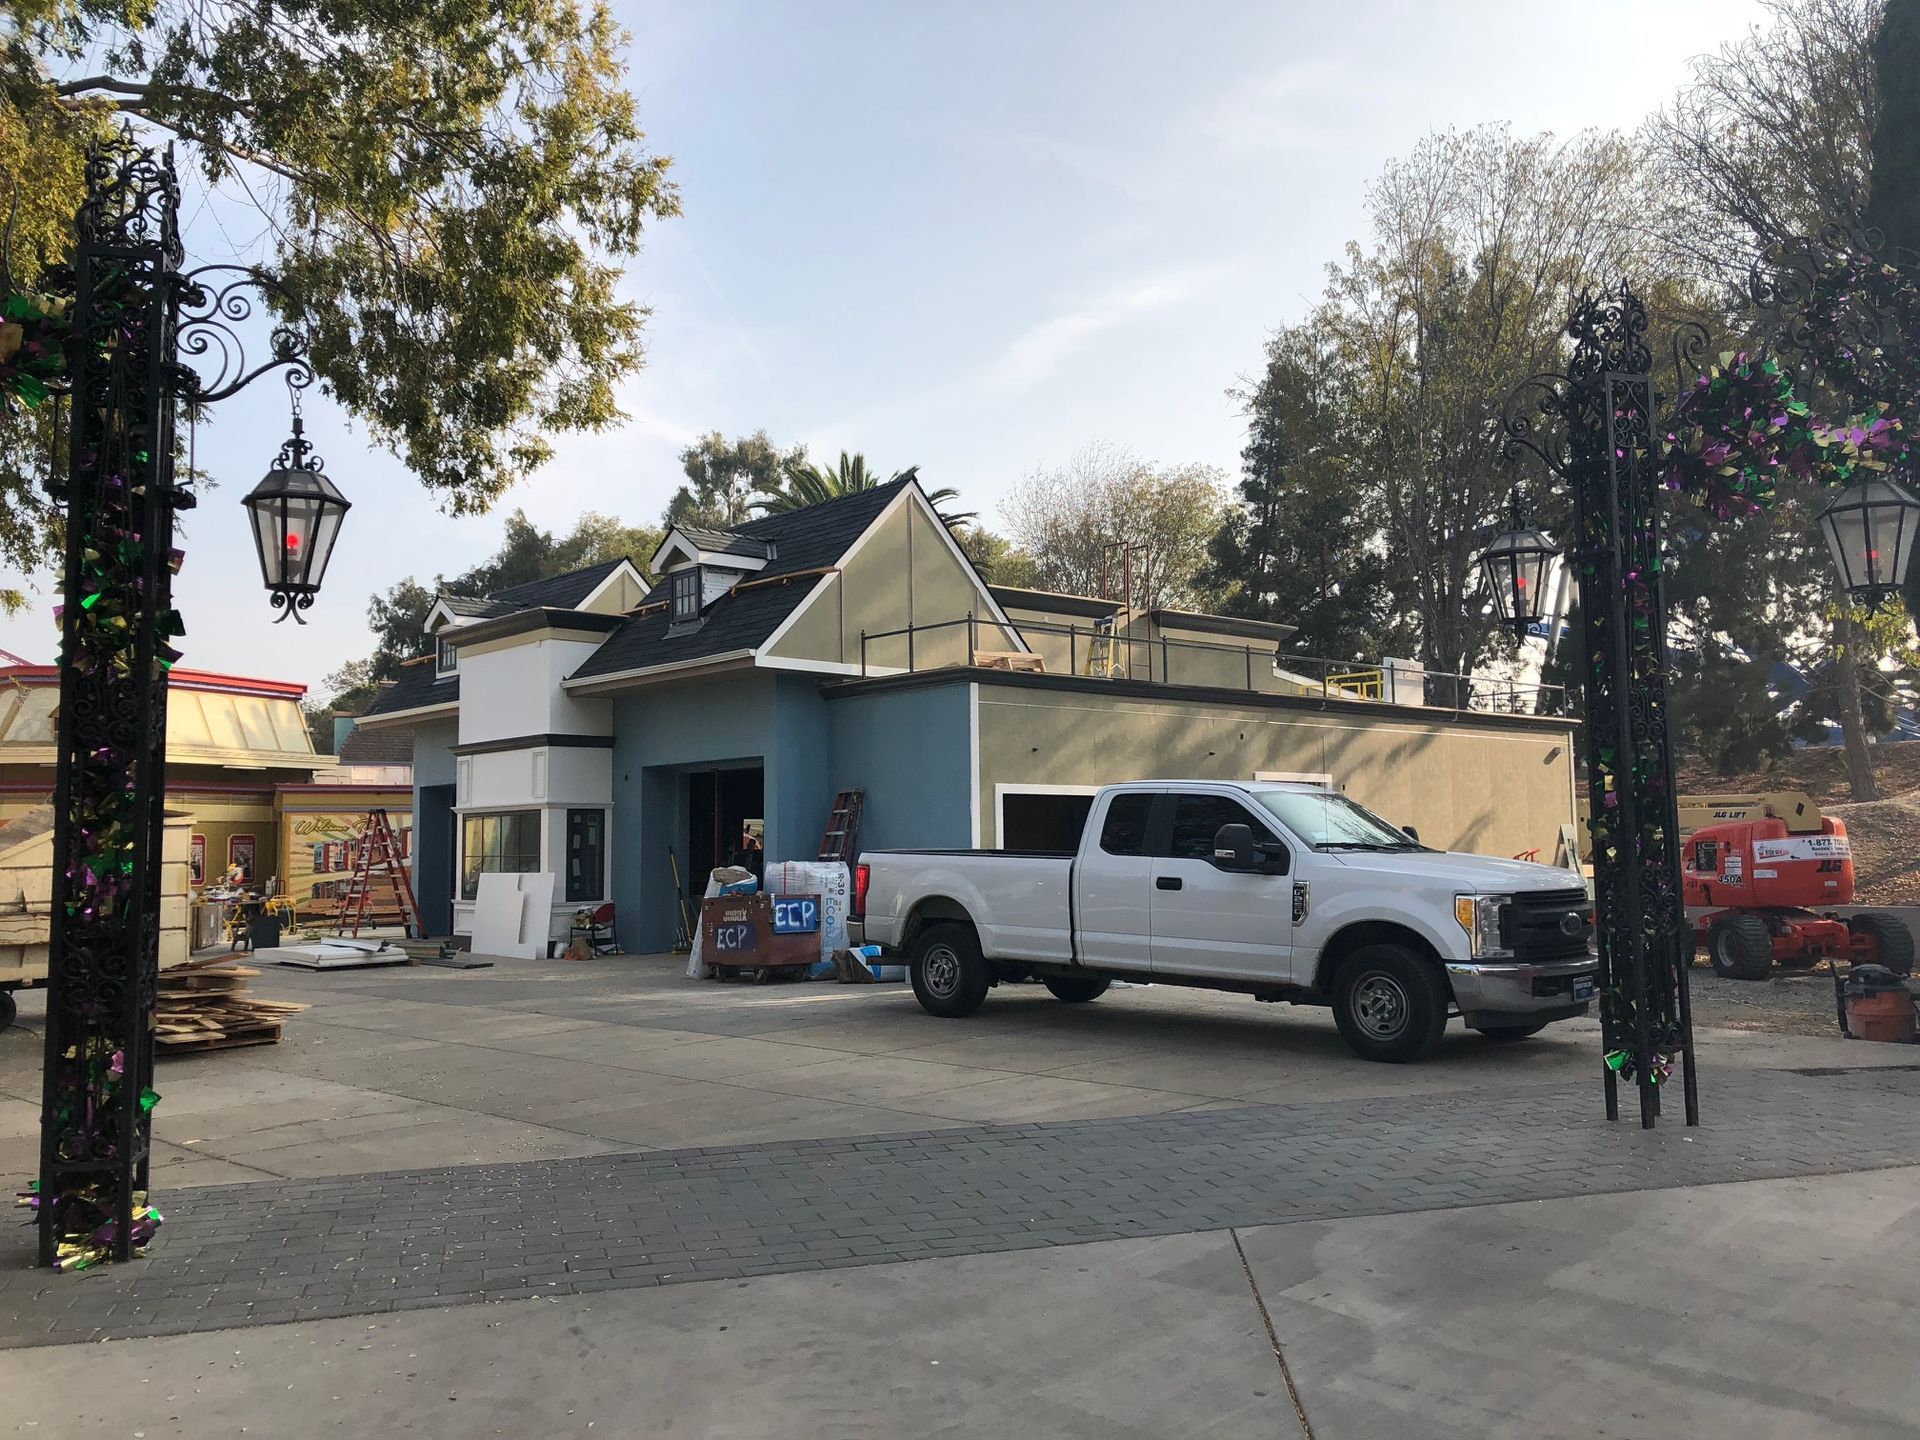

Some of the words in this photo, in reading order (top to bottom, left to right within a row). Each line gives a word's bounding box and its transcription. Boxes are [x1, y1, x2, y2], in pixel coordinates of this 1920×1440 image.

[294, 818, 350, 835] Welcome
[1729, 811, 1747, 819] LIFT
[837, 872, 846, 896] R-30
[774, 900, 815, 928] ECP
[716, 925, 748, 950] ECP
